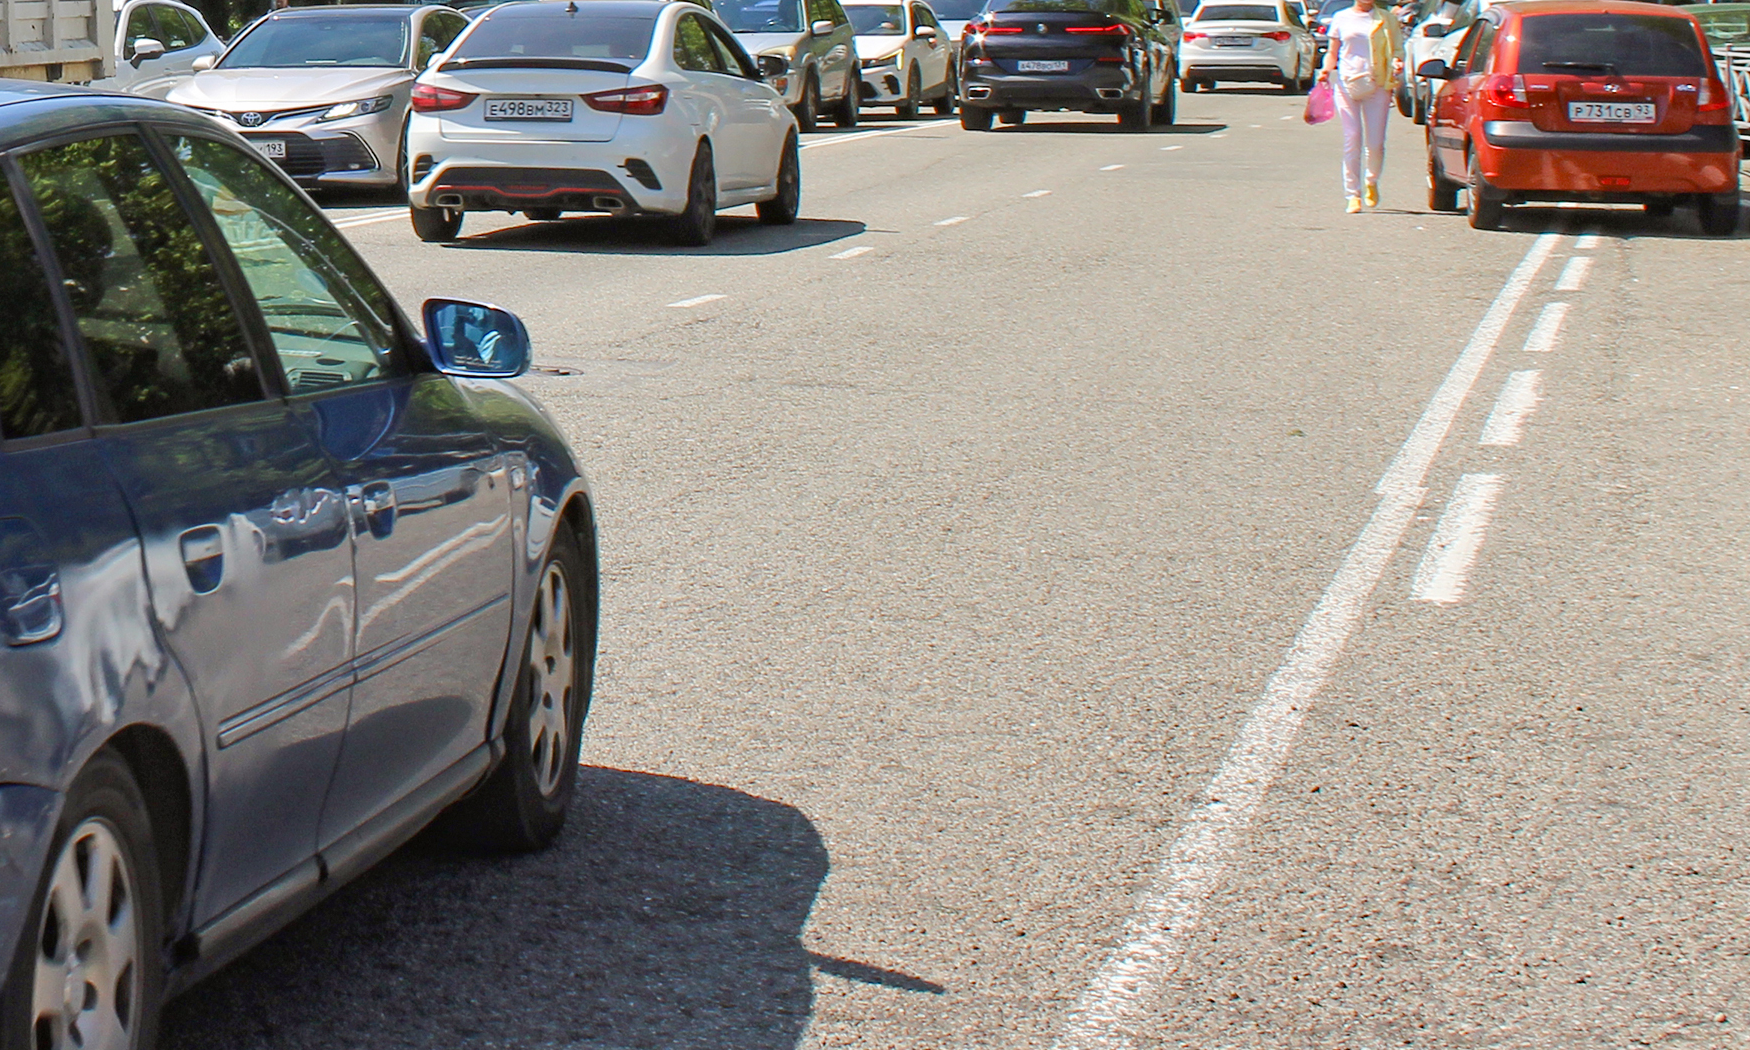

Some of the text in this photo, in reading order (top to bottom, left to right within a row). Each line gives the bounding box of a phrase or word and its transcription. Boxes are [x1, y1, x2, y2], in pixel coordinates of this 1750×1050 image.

[547, 102, 568, 112] 323
[1636, 105, 1649, 115] 93
[266, 143, 283, 152] 193
